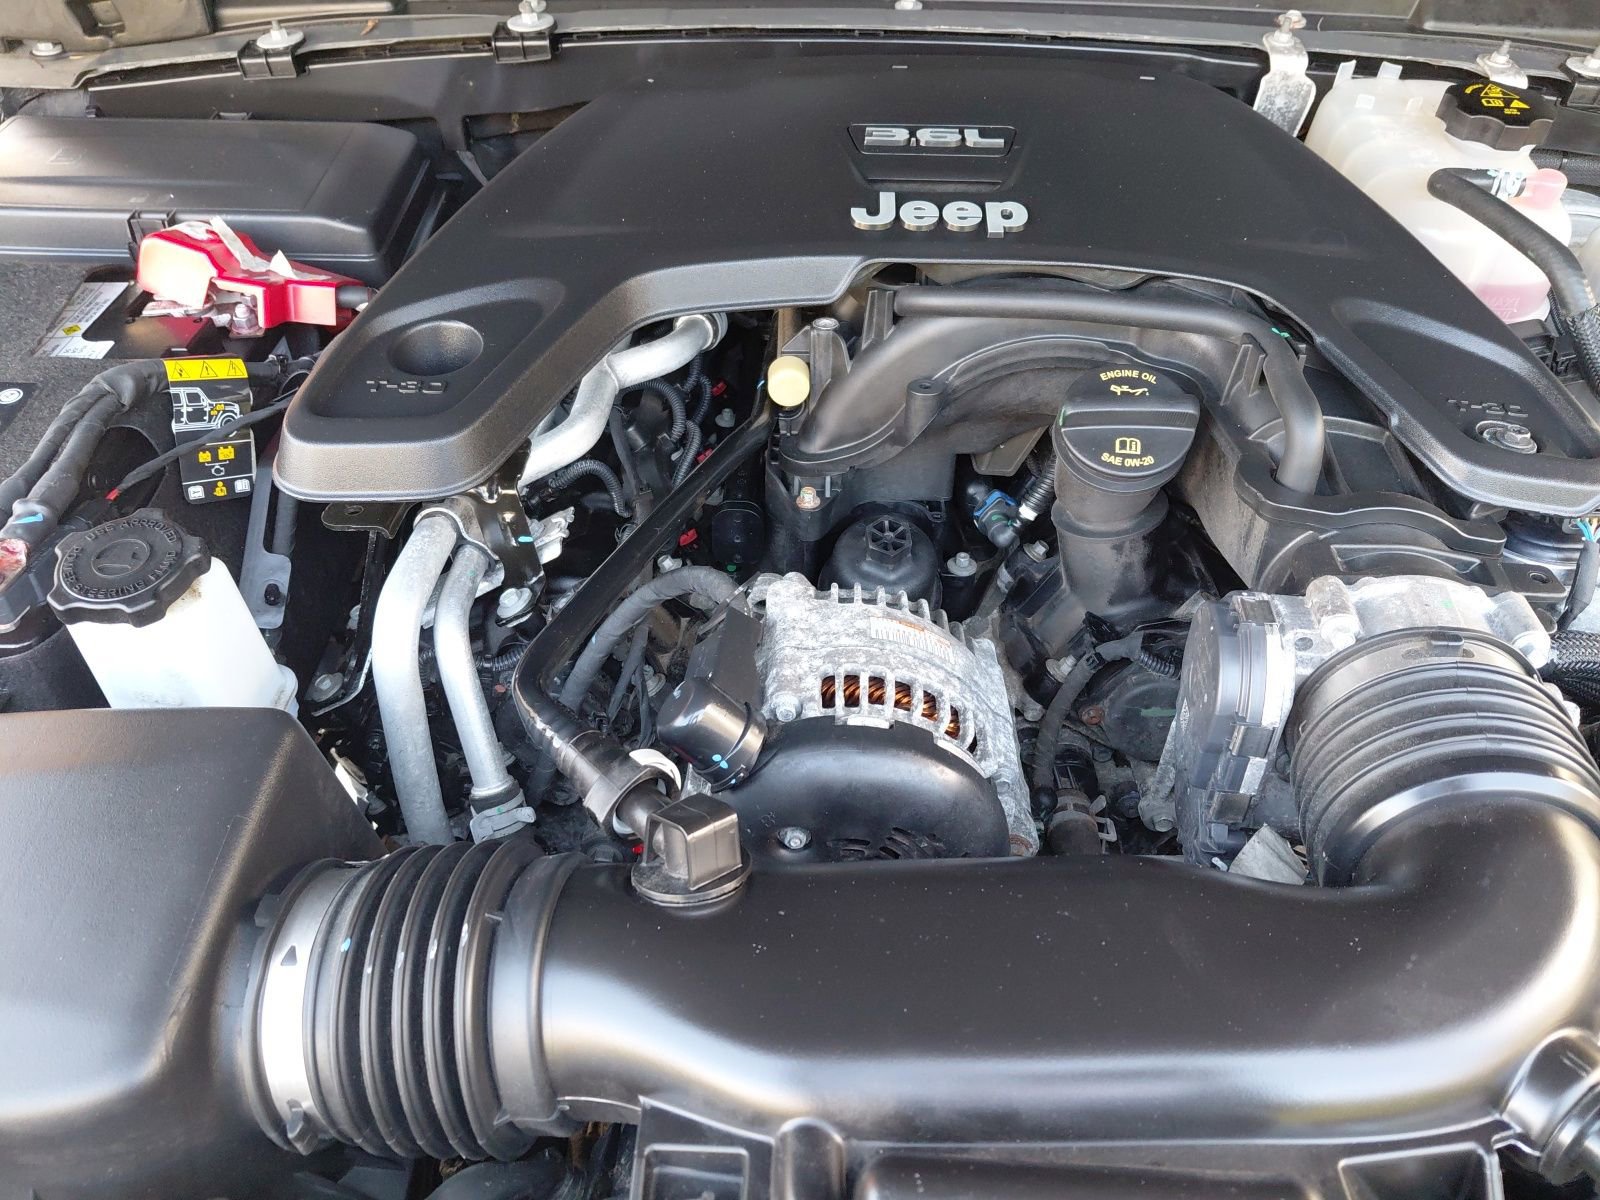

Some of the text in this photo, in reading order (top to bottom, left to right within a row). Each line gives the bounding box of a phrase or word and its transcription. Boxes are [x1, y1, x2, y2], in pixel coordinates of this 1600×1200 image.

[864, 127, 1005, 148] 3.6L
[850, 191, 1028, 238] Jeep
[1100, 370, 1157, 384] ENGINE OIL
[1101, 452, 1154, 467] SAE 0W-20
[85, 518, 177, 544] USE APPROVED
[62, 545, 82, 585] POWER
[72, 581, 146, 599] STEERING
